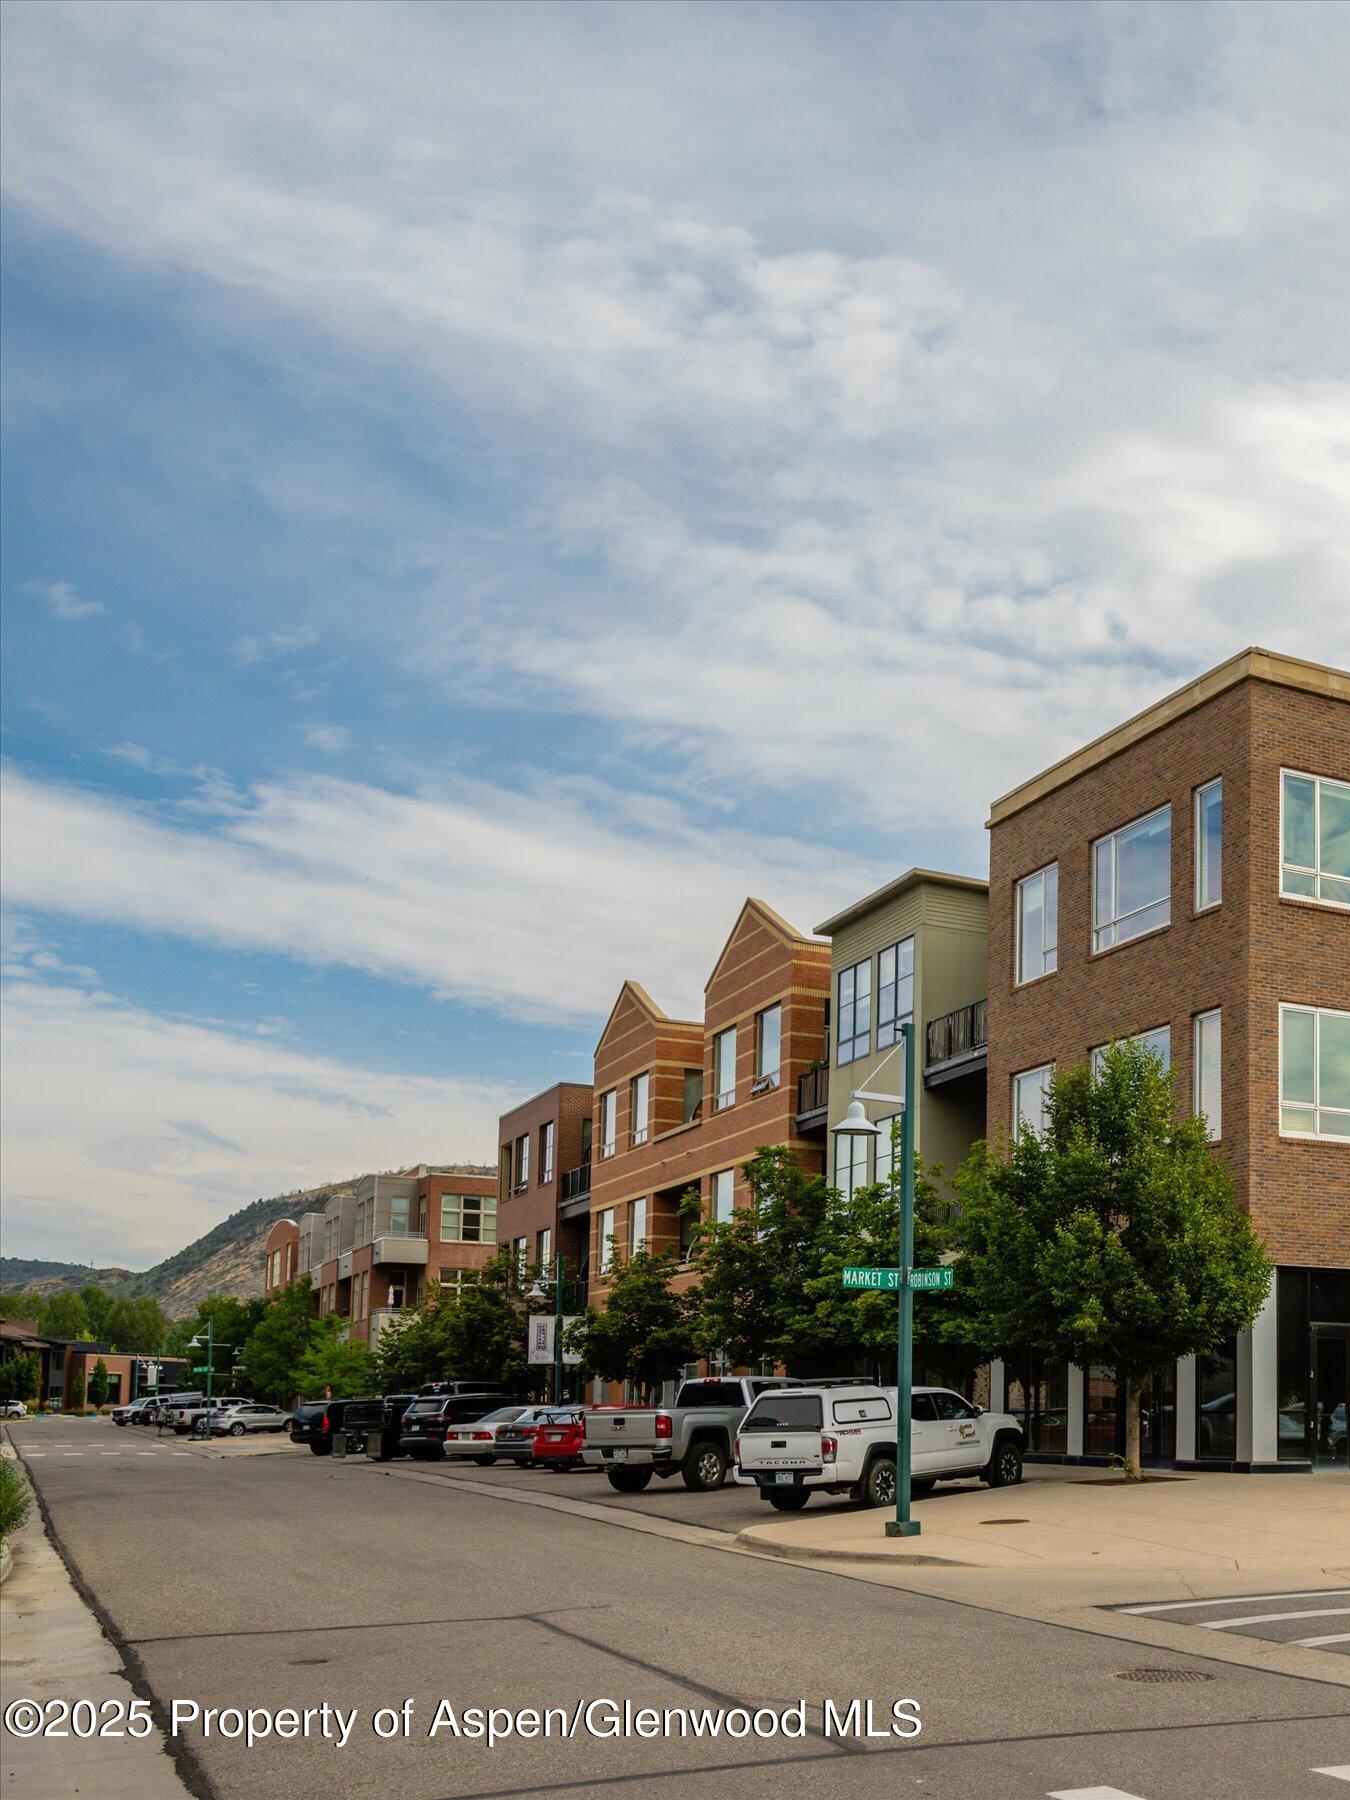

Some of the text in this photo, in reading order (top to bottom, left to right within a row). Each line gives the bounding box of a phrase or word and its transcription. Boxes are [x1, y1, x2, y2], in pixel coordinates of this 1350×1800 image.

[843, 1270, 899, 1287] MARKET ST
[910, 1271, 952, 1287] ROBINSON ST
